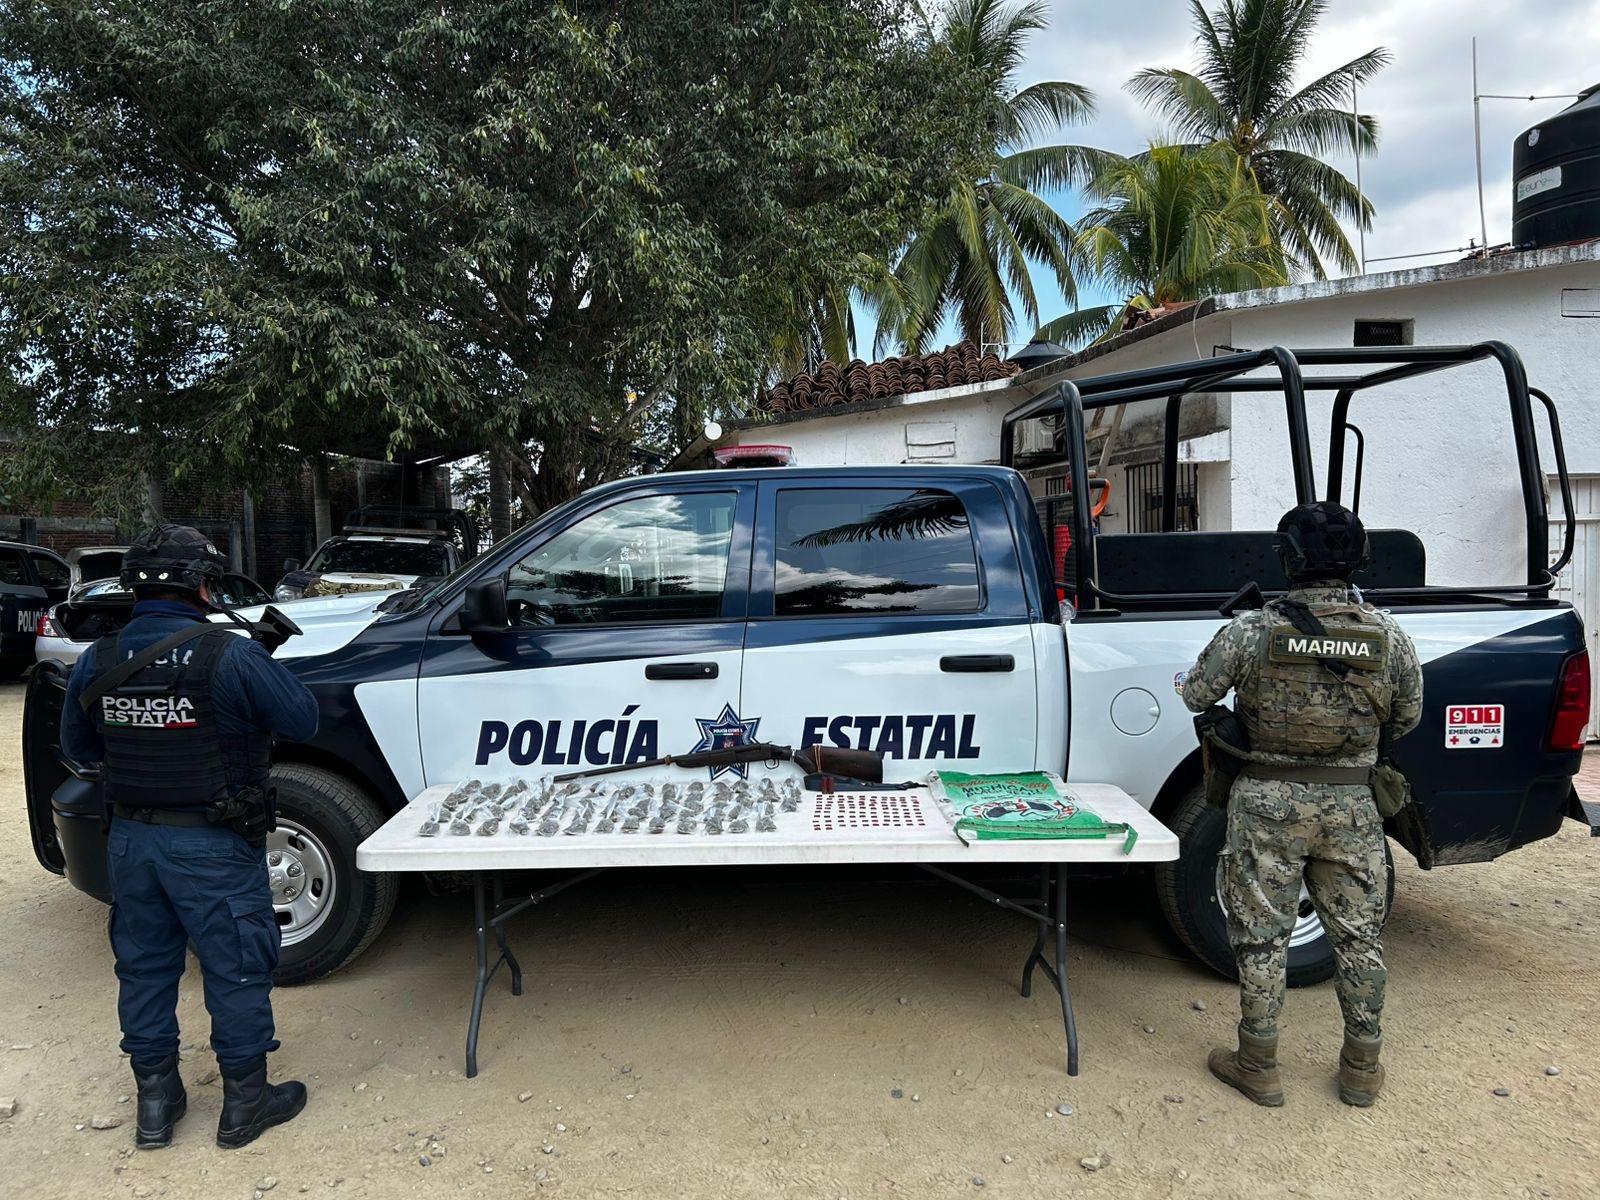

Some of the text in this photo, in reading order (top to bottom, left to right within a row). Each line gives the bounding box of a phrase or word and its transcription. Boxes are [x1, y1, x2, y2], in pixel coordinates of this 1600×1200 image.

[1288, 638, 1370, 656] MARINA
[102, 696, 194, 711] POLICÍA
[103, 709, 196, 724] ESTATAL
[1453, 709, 1496, 722] 911
[475, 705, 980, 766] POLICÍA ESTATAL
